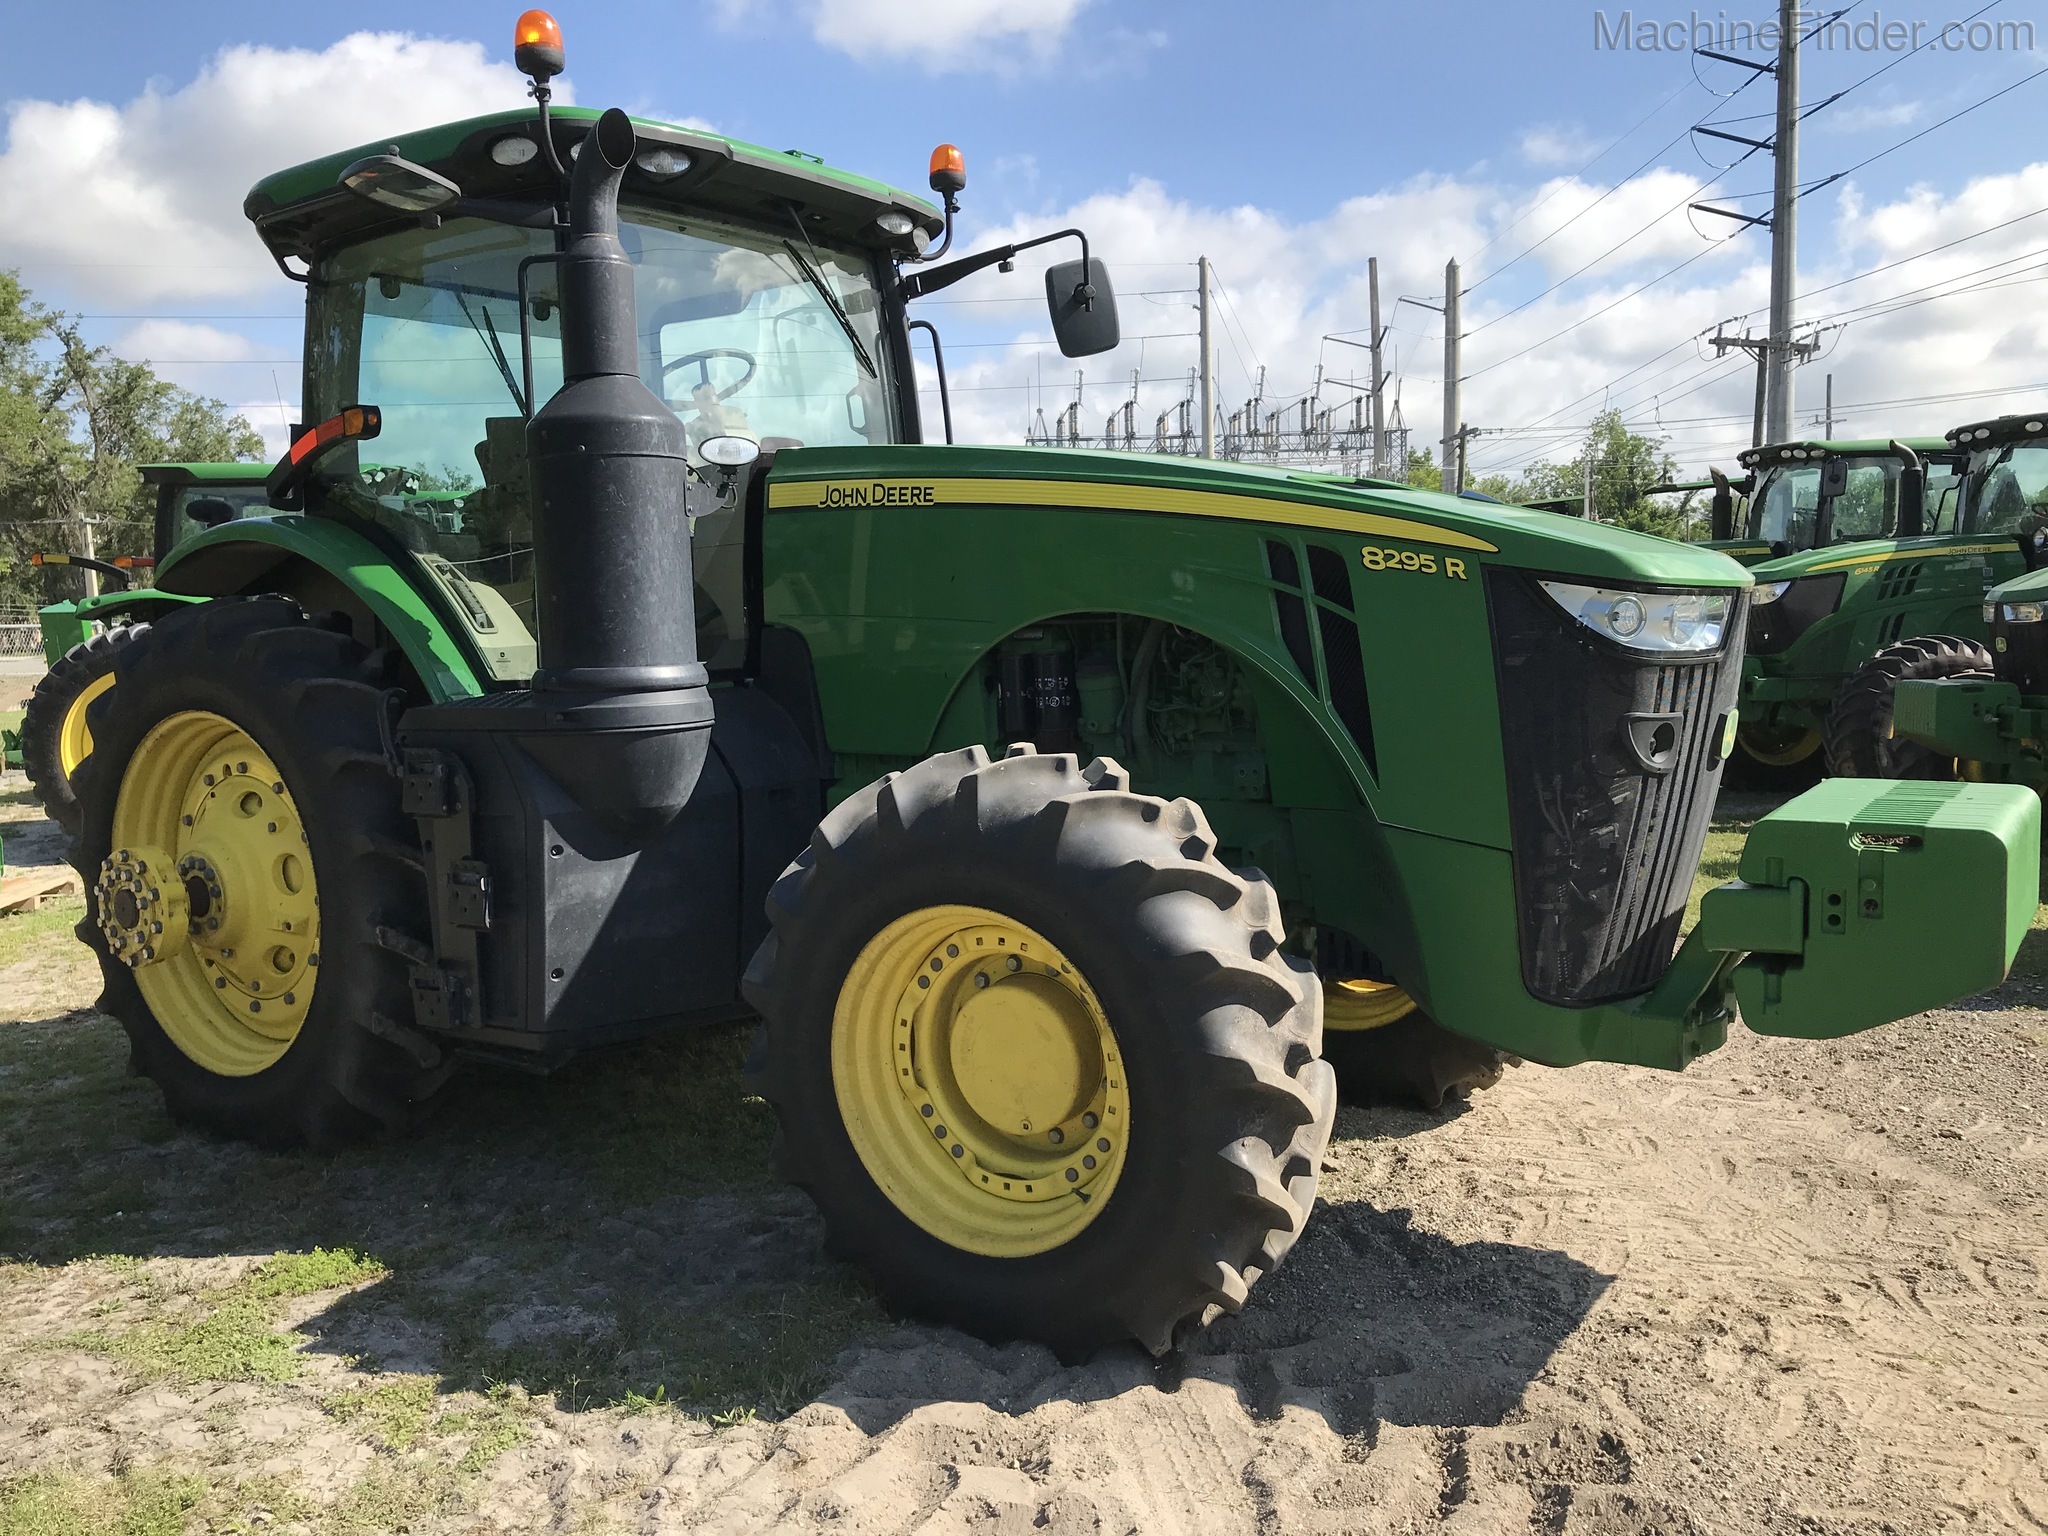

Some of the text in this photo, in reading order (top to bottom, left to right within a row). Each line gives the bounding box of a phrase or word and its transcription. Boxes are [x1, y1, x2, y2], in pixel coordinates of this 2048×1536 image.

[819, 483, 935, 507] JOHN DEERE
[1361, 545, 1468, 580] 8295 R
[1948, 546, 1992, 555] JOHN DEERE
